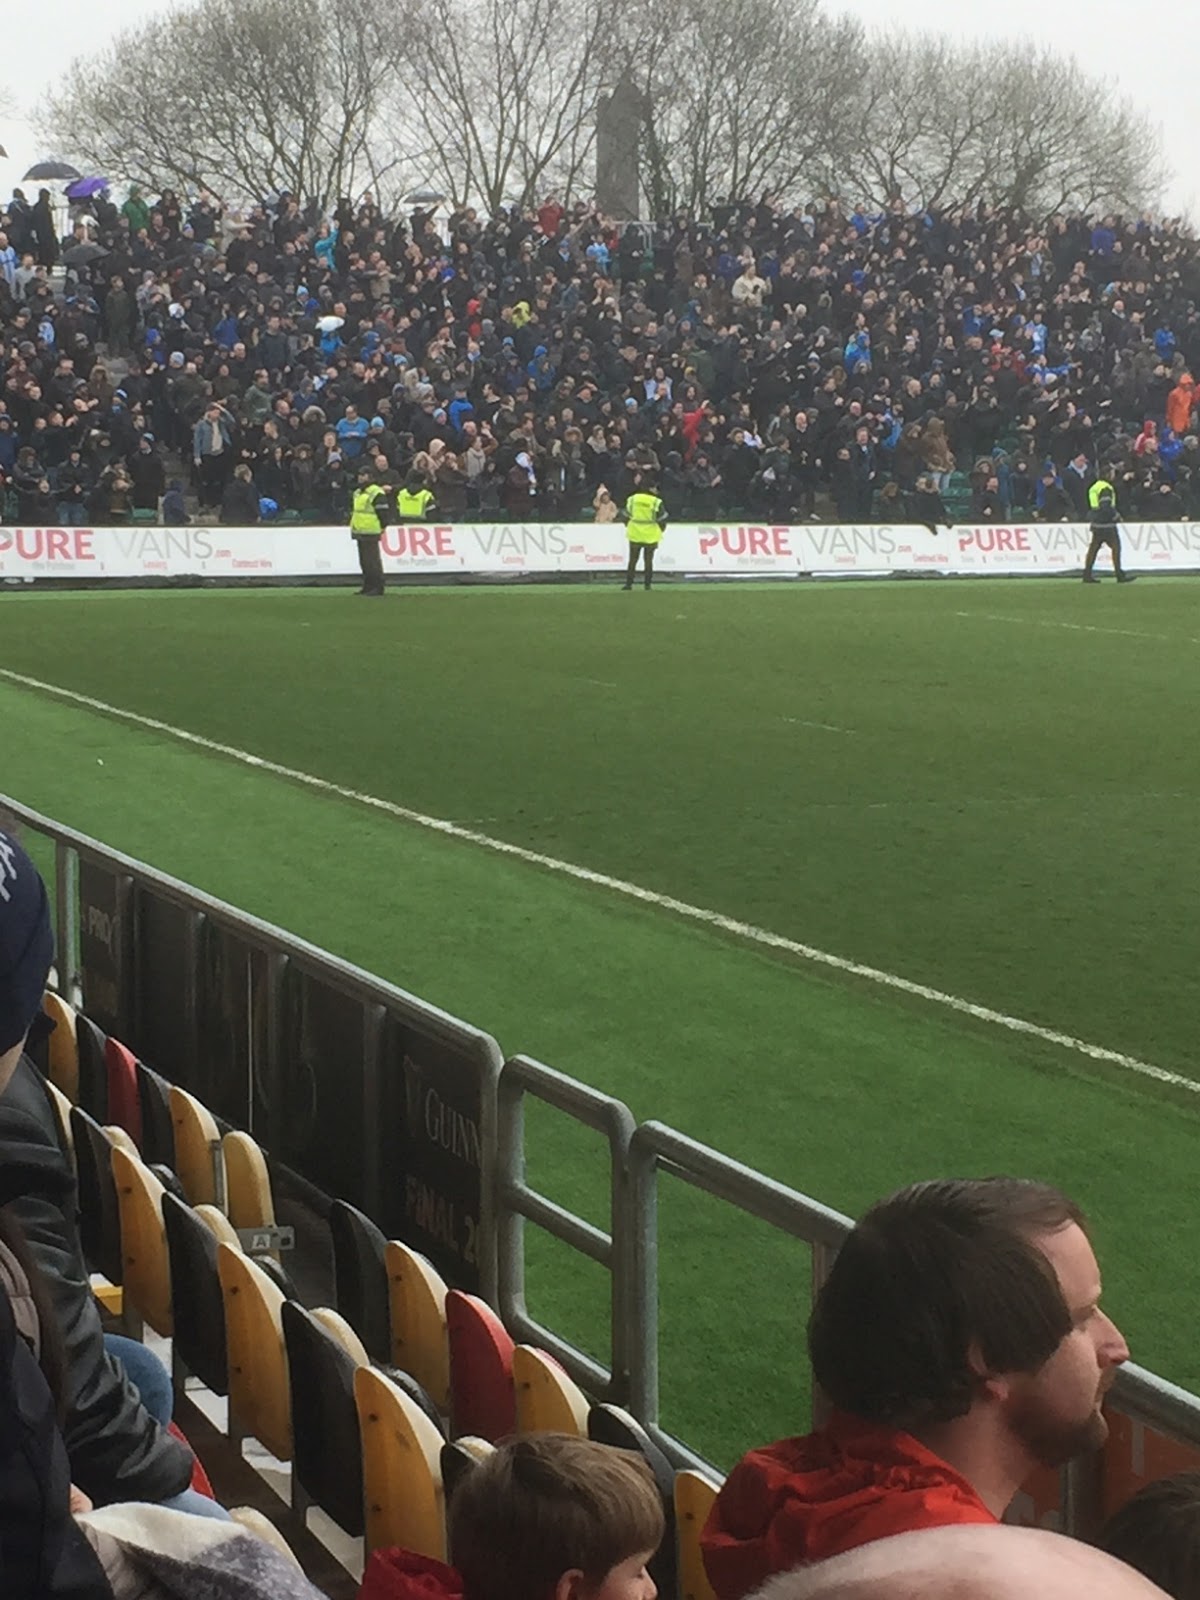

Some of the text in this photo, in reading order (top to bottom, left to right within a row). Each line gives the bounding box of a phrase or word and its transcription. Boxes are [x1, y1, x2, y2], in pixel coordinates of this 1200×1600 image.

[112, 529, 213, 559] VANS
[379, 527, 456, 557] URE
[472, 526, 567, 555] VANS
[698, 527, 793, 555] PURE
[805, 527, 896, 555] VANS
[958, 528, 1031, 551] PURE
[1034, 528, 1090, 550] VAN
